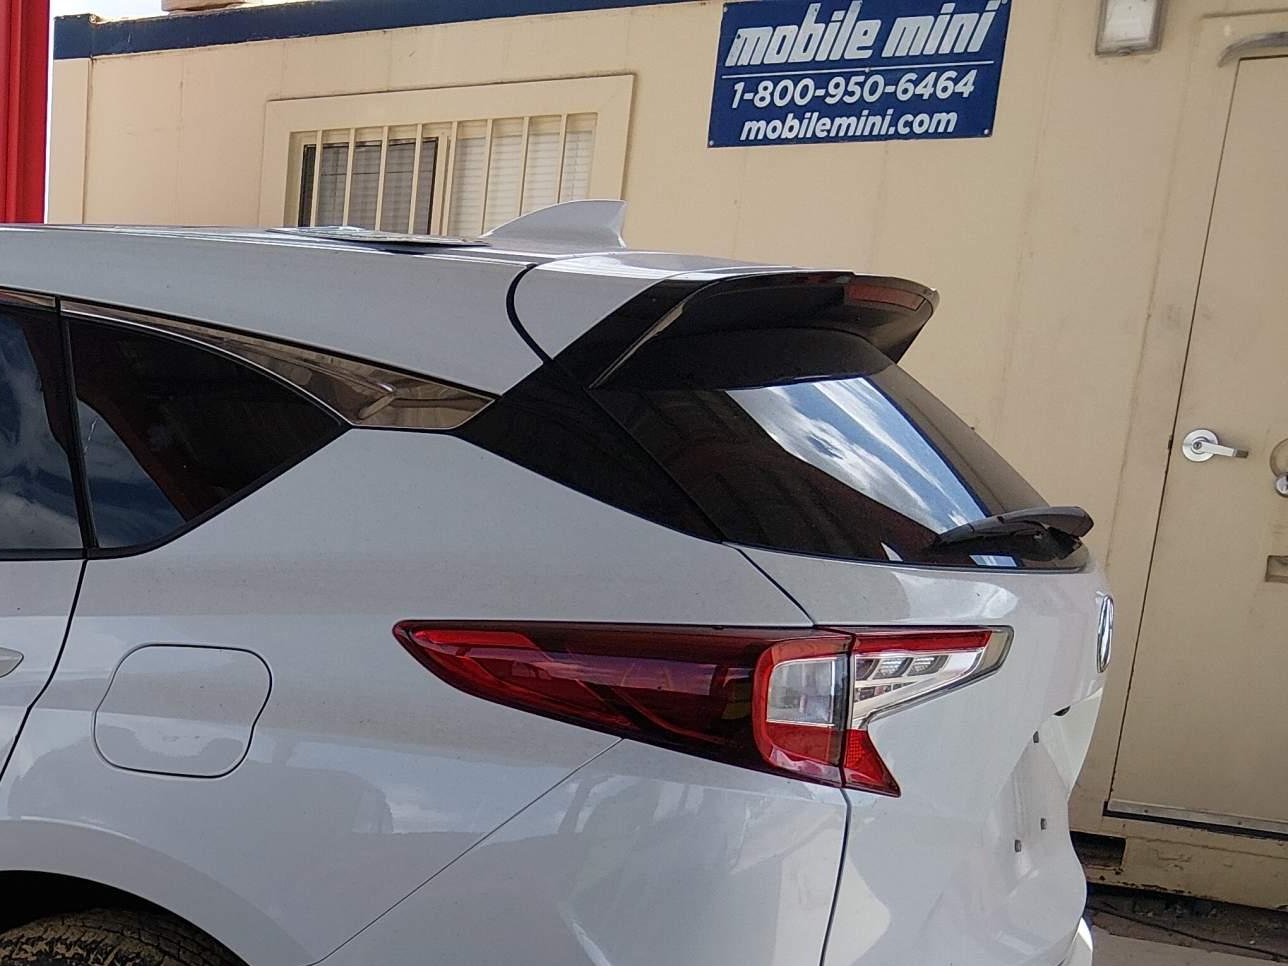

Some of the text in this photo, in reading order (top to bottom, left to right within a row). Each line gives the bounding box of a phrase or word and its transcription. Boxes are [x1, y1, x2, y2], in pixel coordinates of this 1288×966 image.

[725, 0, 1002, 66] mobile mini
[731, 69, 978, 109] 1-800-950-6464
[739, 108, 958, 141] mobilemini.com
